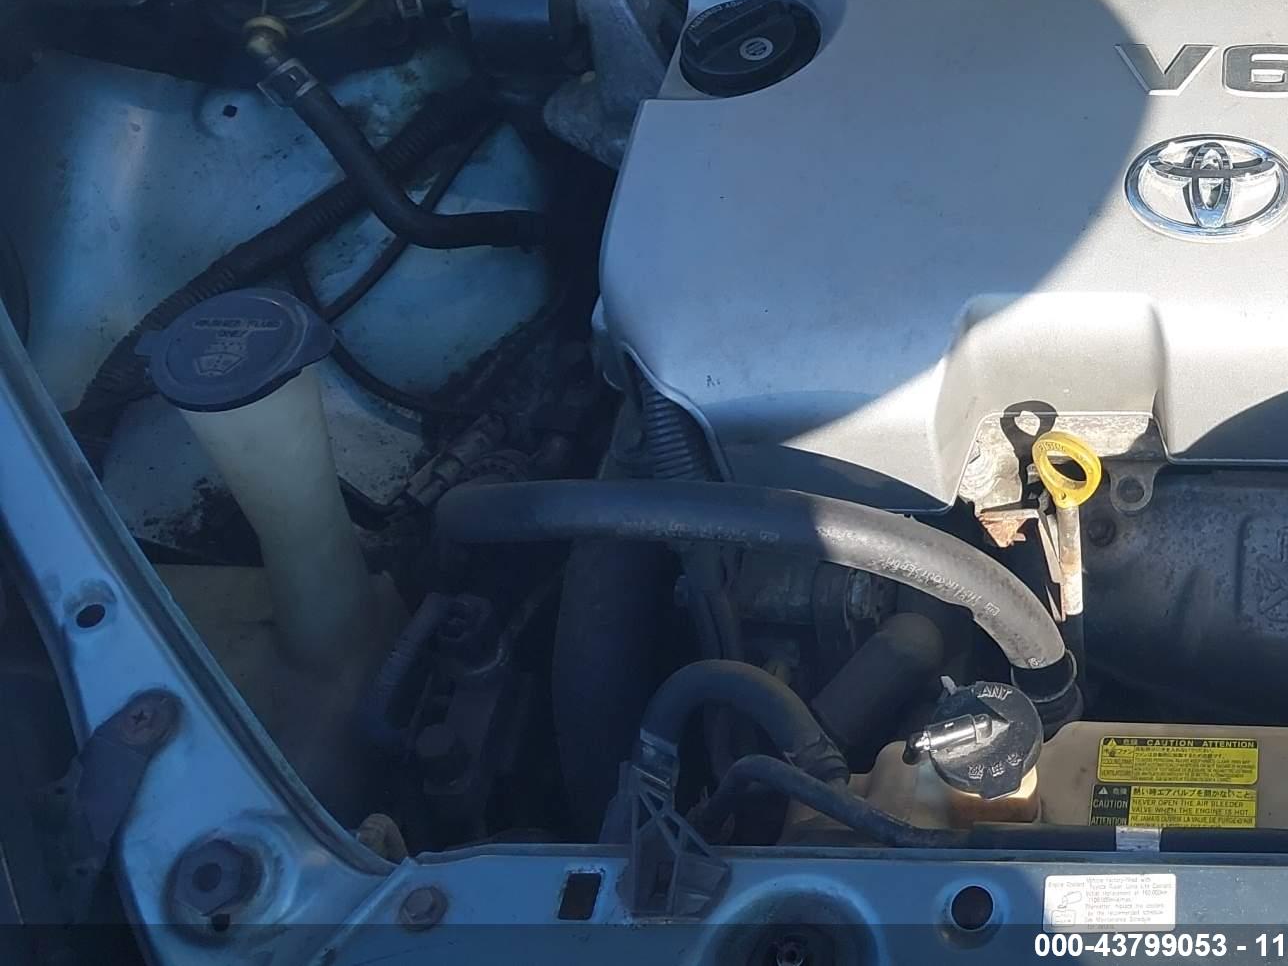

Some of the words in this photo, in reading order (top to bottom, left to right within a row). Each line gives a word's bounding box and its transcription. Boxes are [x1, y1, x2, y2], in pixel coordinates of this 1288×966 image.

[1202, 740, 1255, 748] ATTENTION
[1092, 798, 1128, 809] CAUTION
[1132, 799, 1157, 807] NEVER
[1195, 808, 1222, 816] ENGINE
[1091, 817, 1127, 826] ATTENTION
